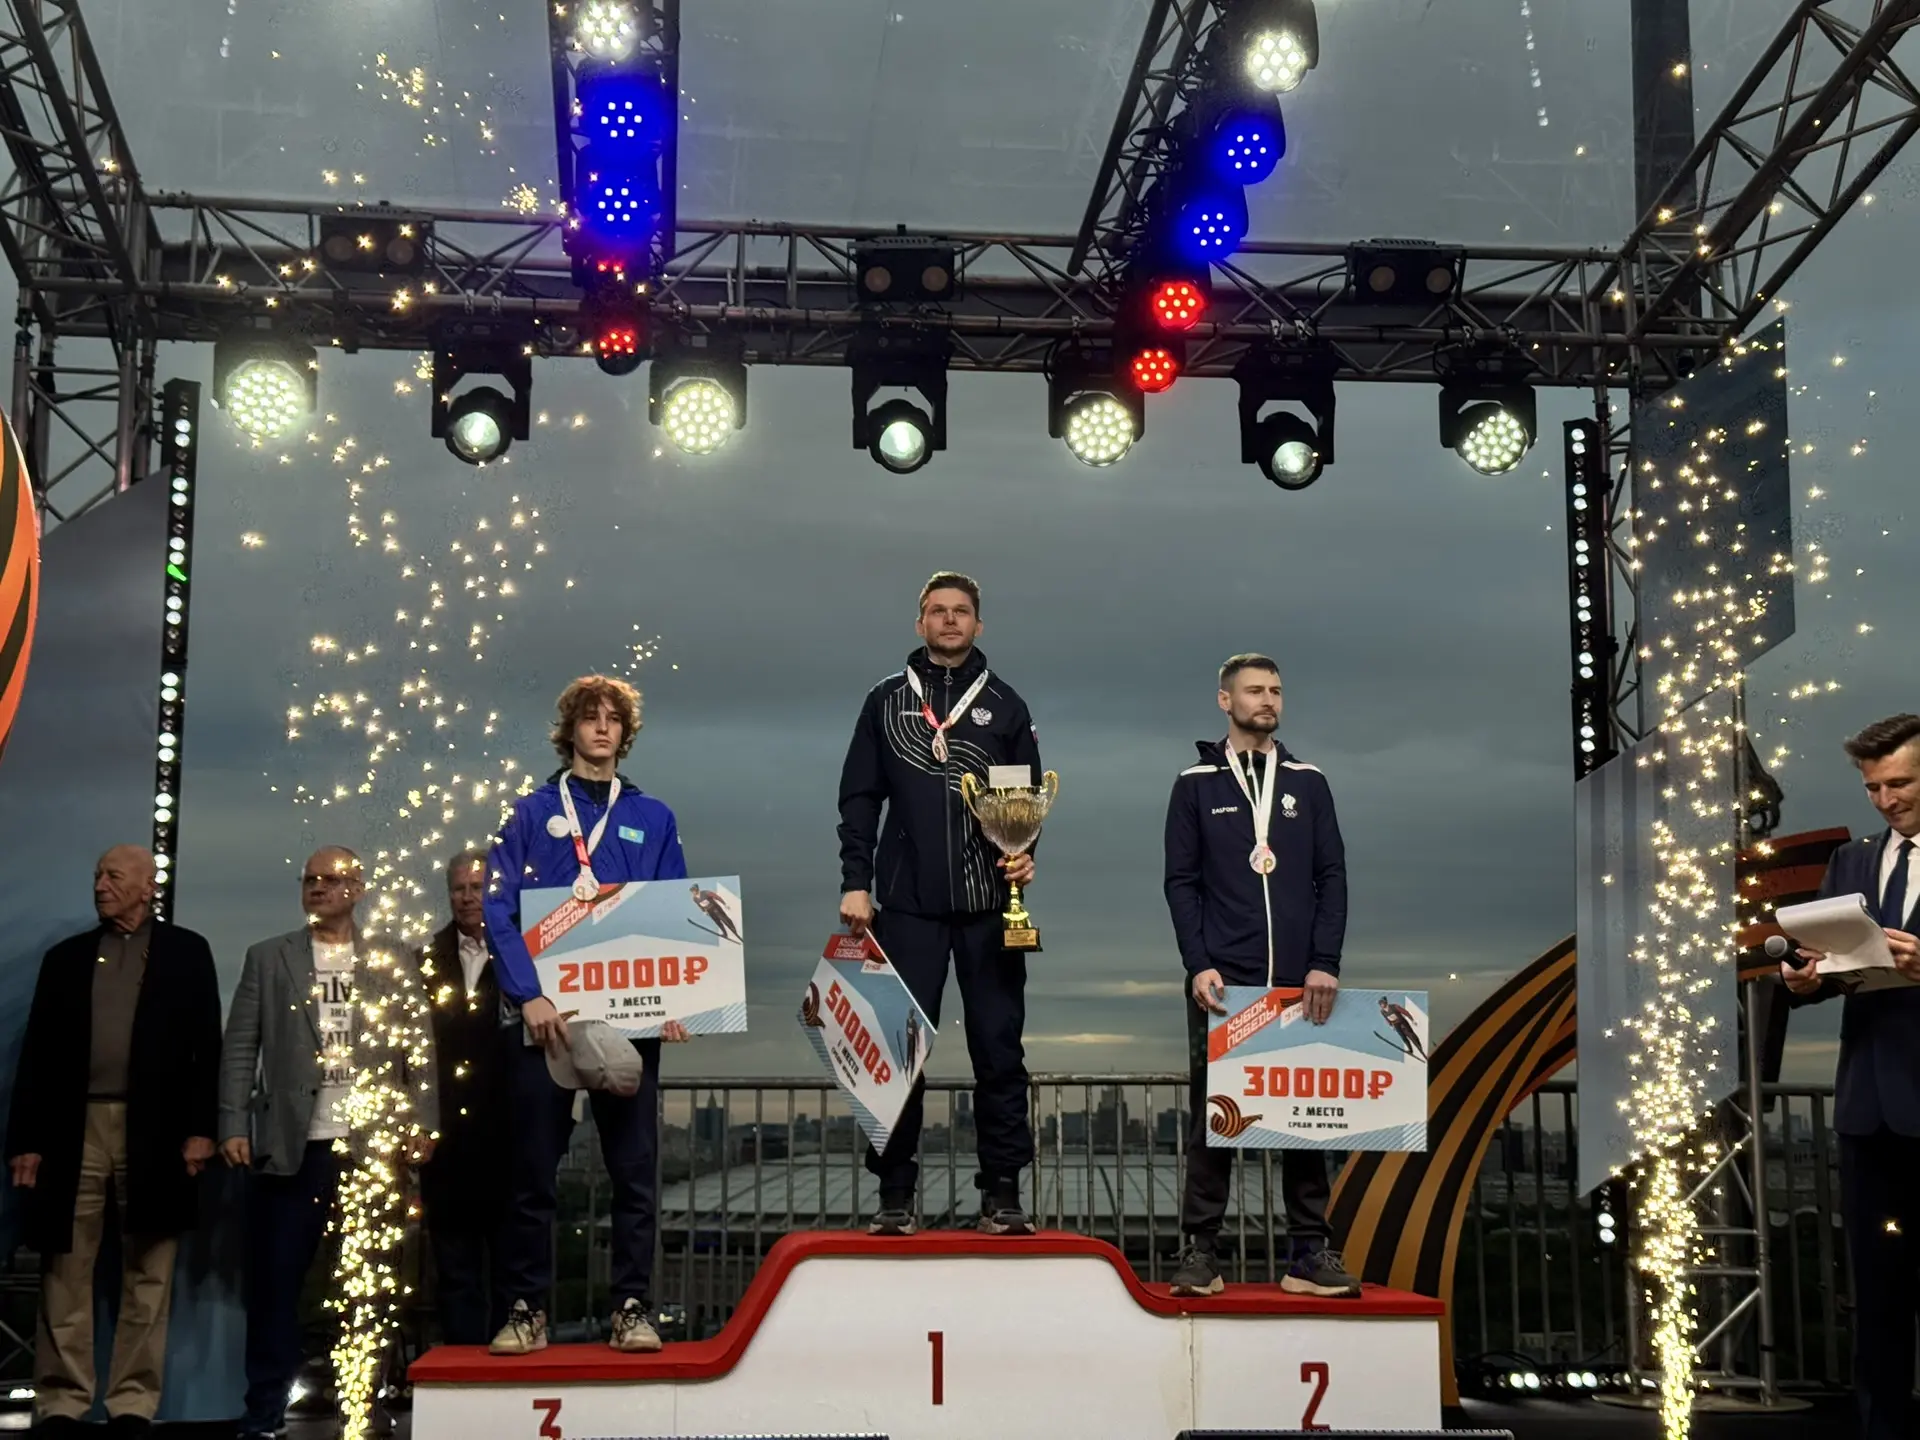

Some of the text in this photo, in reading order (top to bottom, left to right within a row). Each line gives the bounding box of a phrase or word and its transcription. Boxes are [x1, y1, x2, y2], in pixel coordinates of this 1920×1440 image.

[539, 898, 579, 935] КУБОК
[540, 903, 589, 949] ПОБЕДЫ
[558, 956, 709, 993] 20000₽
[608, 996, 662, 1008] 3 МЕСТО
[1227, 997, 1268, 1035] КУБОК
[1227, 1005, 1277, 1049] ПОБЕДЫ
[1243, 1065, 1393, 1100] 30000₽
[1292, 1106, 1345, 1117] 2 МЕСТО
[927, 1331, 943, 1405] 1
[1300, 1362, 1330, 1431] 2
